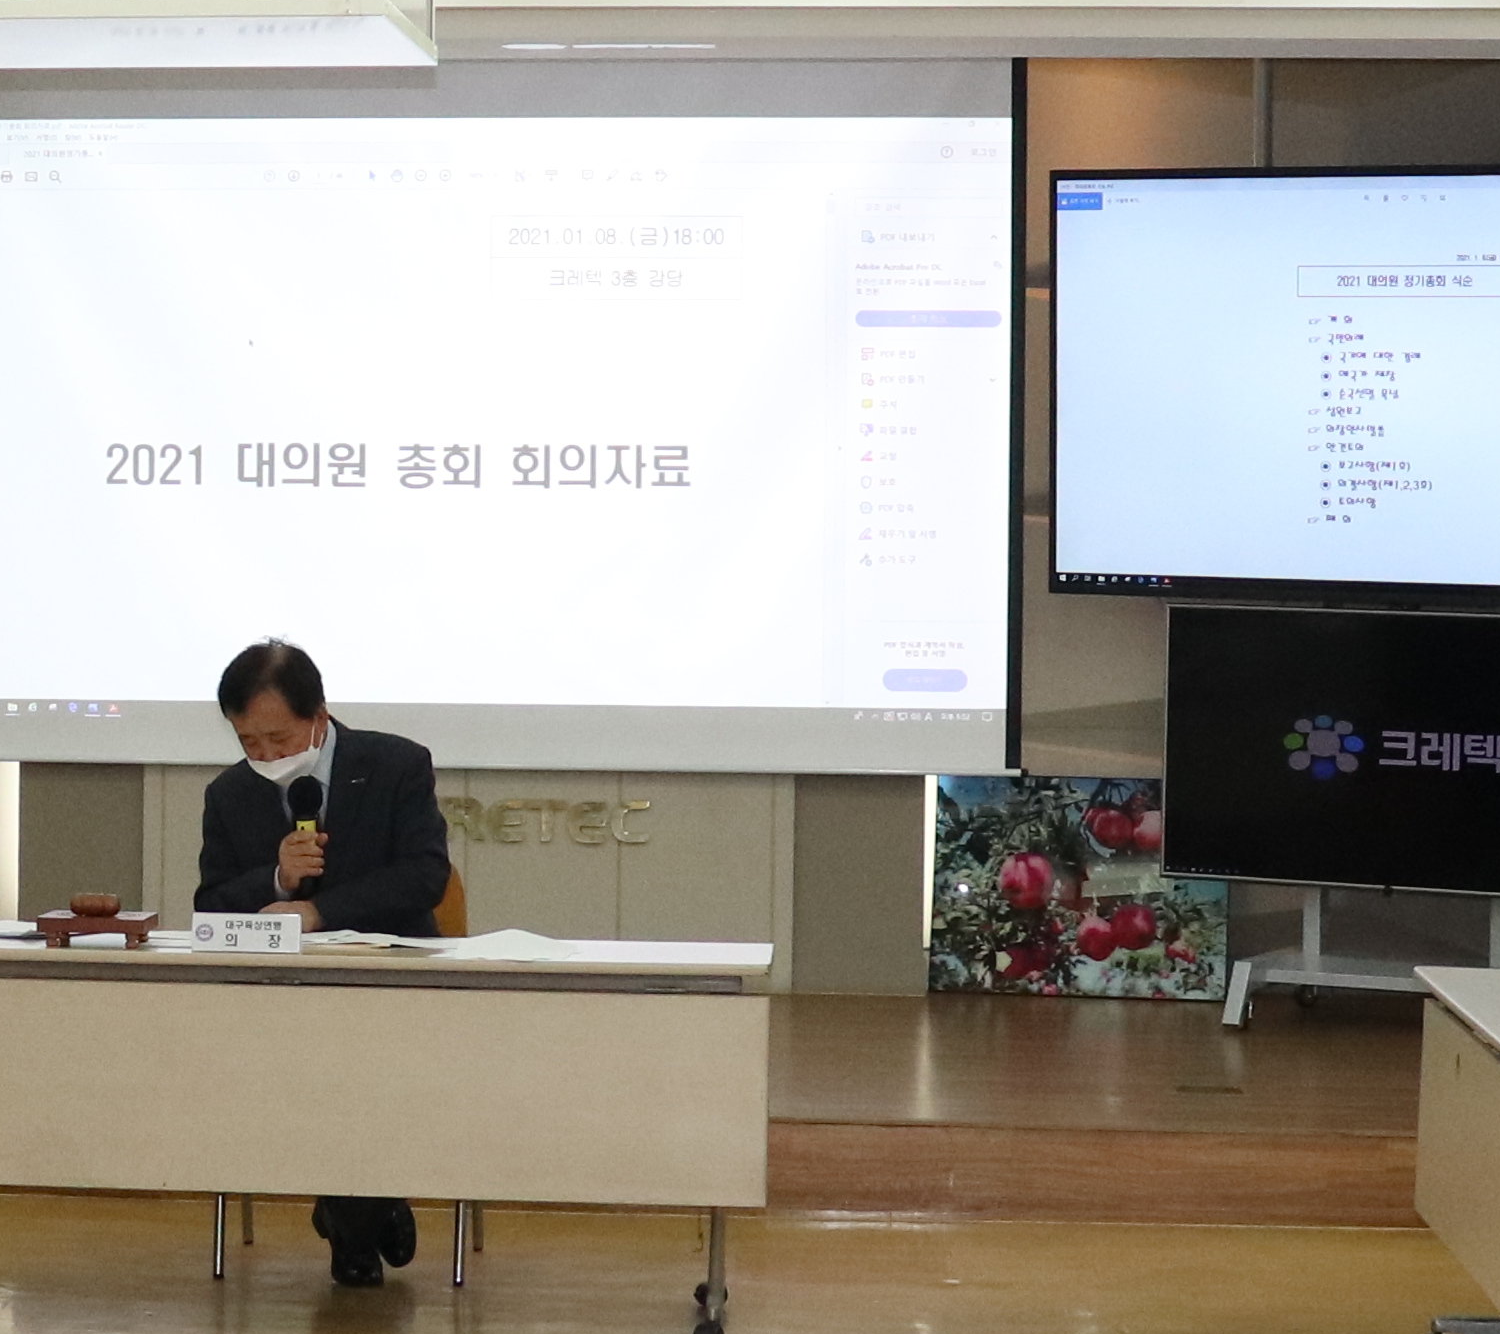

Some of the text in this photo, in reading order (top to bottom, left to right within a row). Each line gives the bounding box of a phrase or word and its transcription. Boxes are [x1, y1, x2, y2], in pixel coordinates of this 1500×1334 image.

[549, 270, 602, 287] 크레텍
[649, 270, 683, 287] 강당
[1337, 275, 1473, 287] 2021 대의원 정기총회 식순
[105, 441, 693, 491] 2021 대의원 총회 회의자료
[438, 796, 651, 844] RETEC
